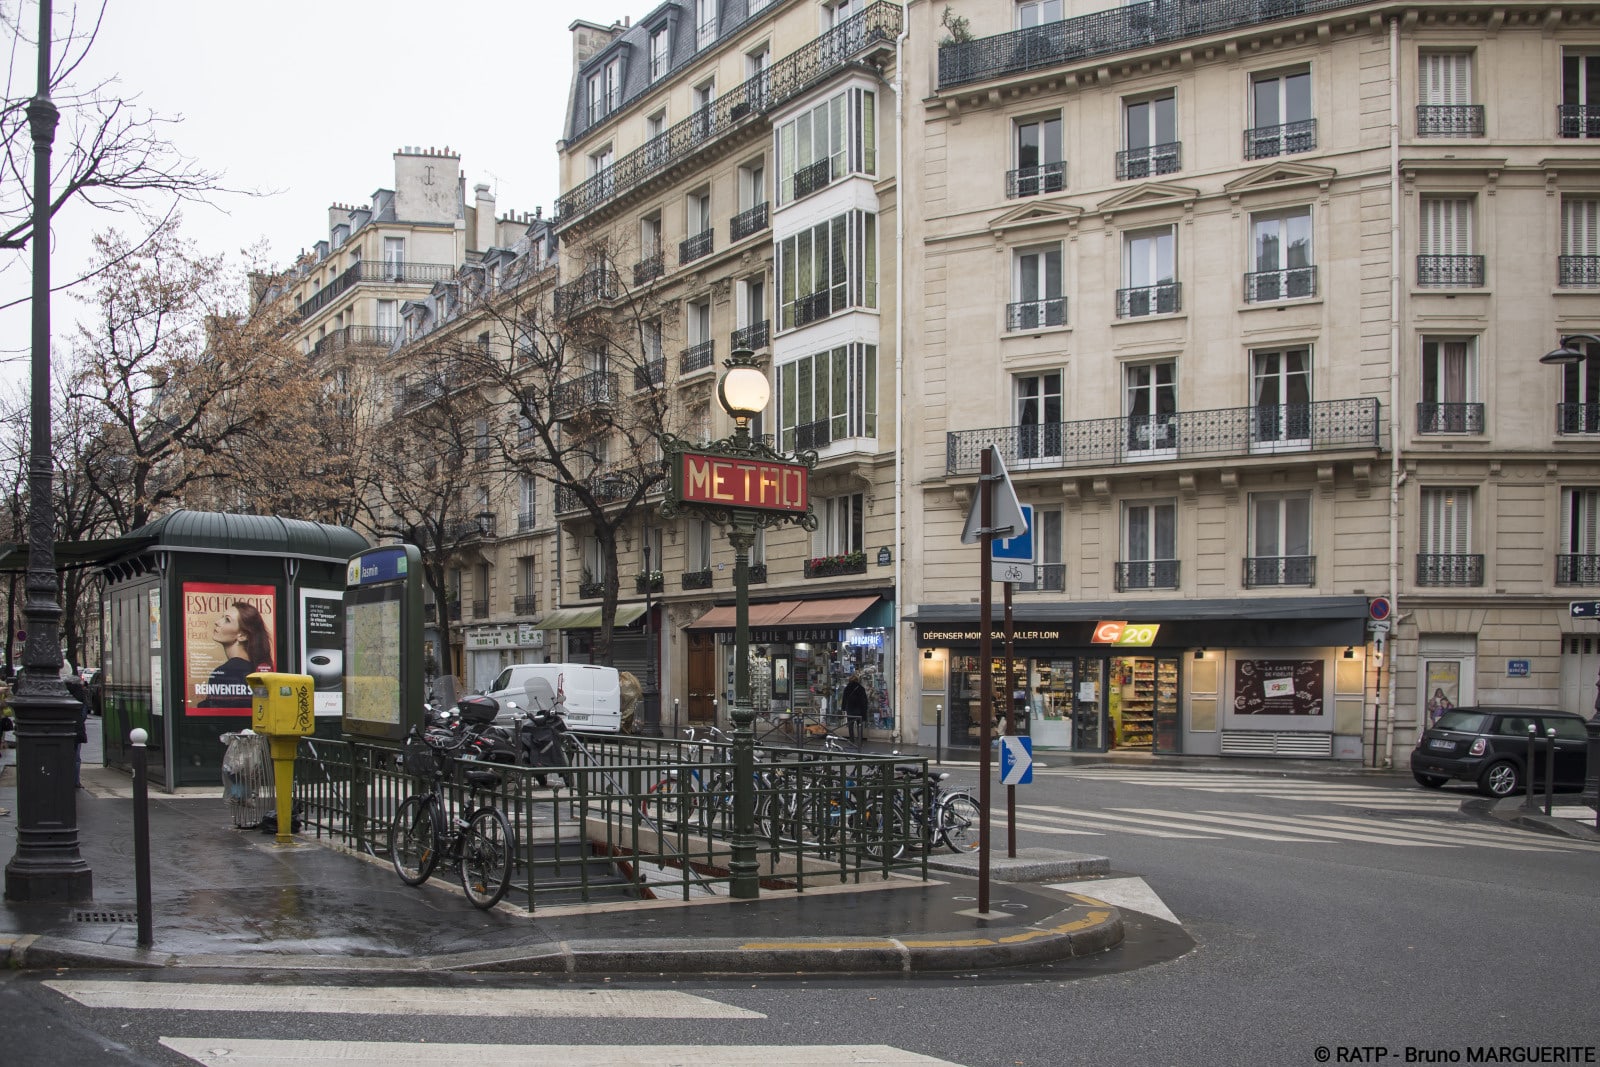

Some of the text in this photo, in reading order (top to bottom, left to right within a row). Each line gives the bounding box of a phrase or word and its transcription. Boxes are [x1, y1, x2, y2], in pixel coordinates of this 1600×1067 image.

[688, 458, 802, 507] METRO
[187, 595, 272, 615] PSYCHOIES
[923, 630, 963, 640] DÉPENSER
[990, 631, 1006, 640] SAN
[1012, 631, 1038, 639] ALLER
[1040, 631, 1059, 639] LOIN
[195, 681, 246, 695] RÉINVENTER
